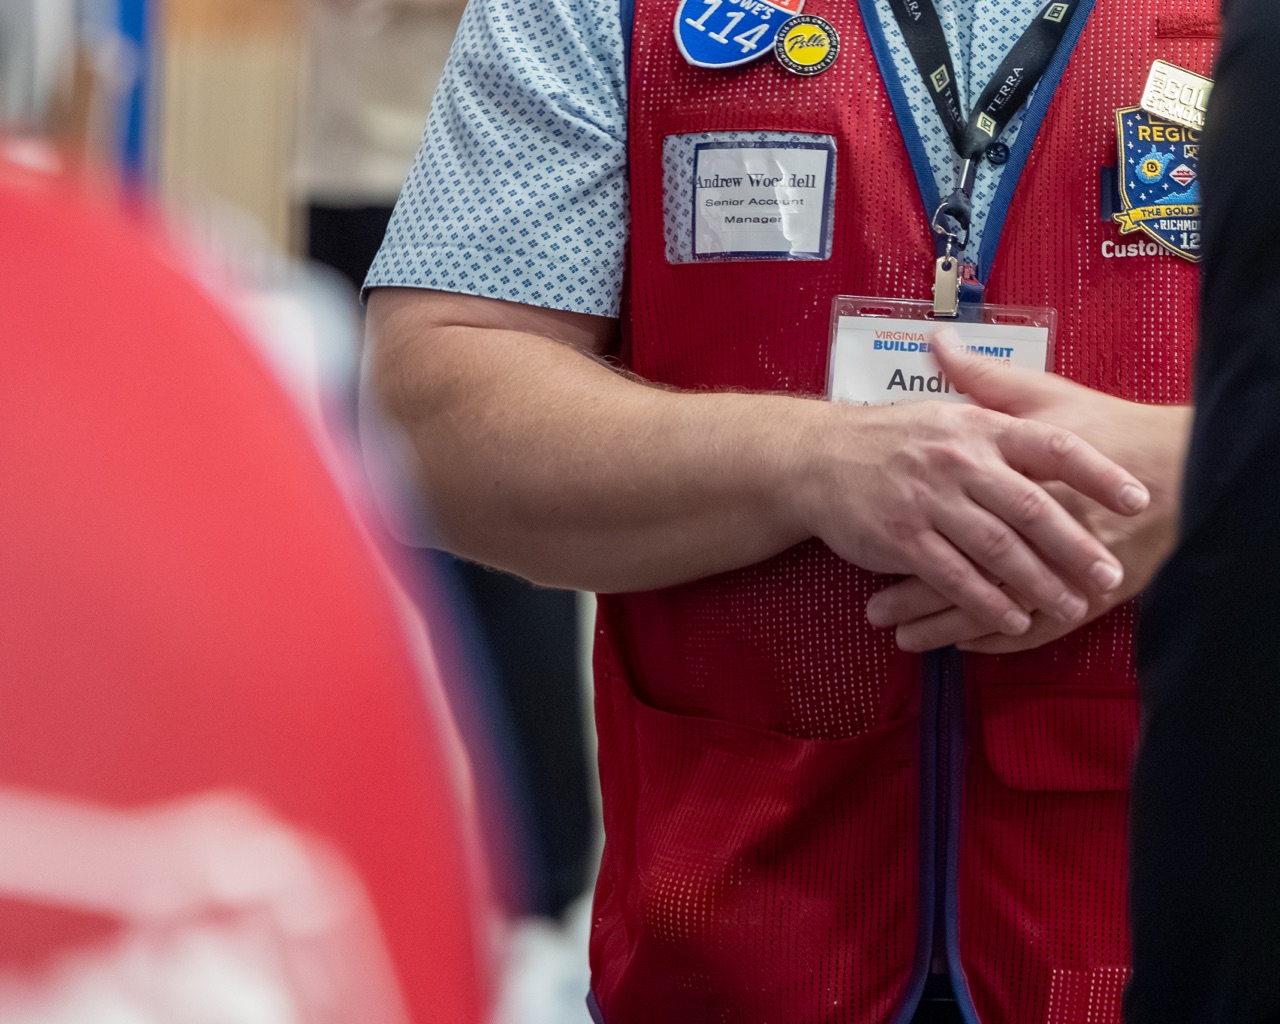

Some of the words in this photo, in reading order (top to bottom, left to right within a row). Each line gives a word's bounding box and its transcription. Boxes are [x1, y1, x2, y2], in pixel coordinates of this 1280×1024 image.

[788, 33, 826, 53] Pella
[987, 68, 1023, 111] TERRA
[1163, 79, 1207, 112] GOL
[1138, 125, 1199, 143] REGIO
[695, 174, 743, 188] Andrew
[747, 173, 816, 188] Woodell
[705, 198, 744, 207] Senior
[748, 198, 804, 206] Account
[1141, 208, 1161, 217] THE
[1165, 206, 1194, 217] GOLD
[724, 215, 782, 224] Manager
[1160, 219, 1200, 231] RICHMO
[1180, 232, 1200, 249] 12
[875, 330, 925, 342] VIRGINIA
